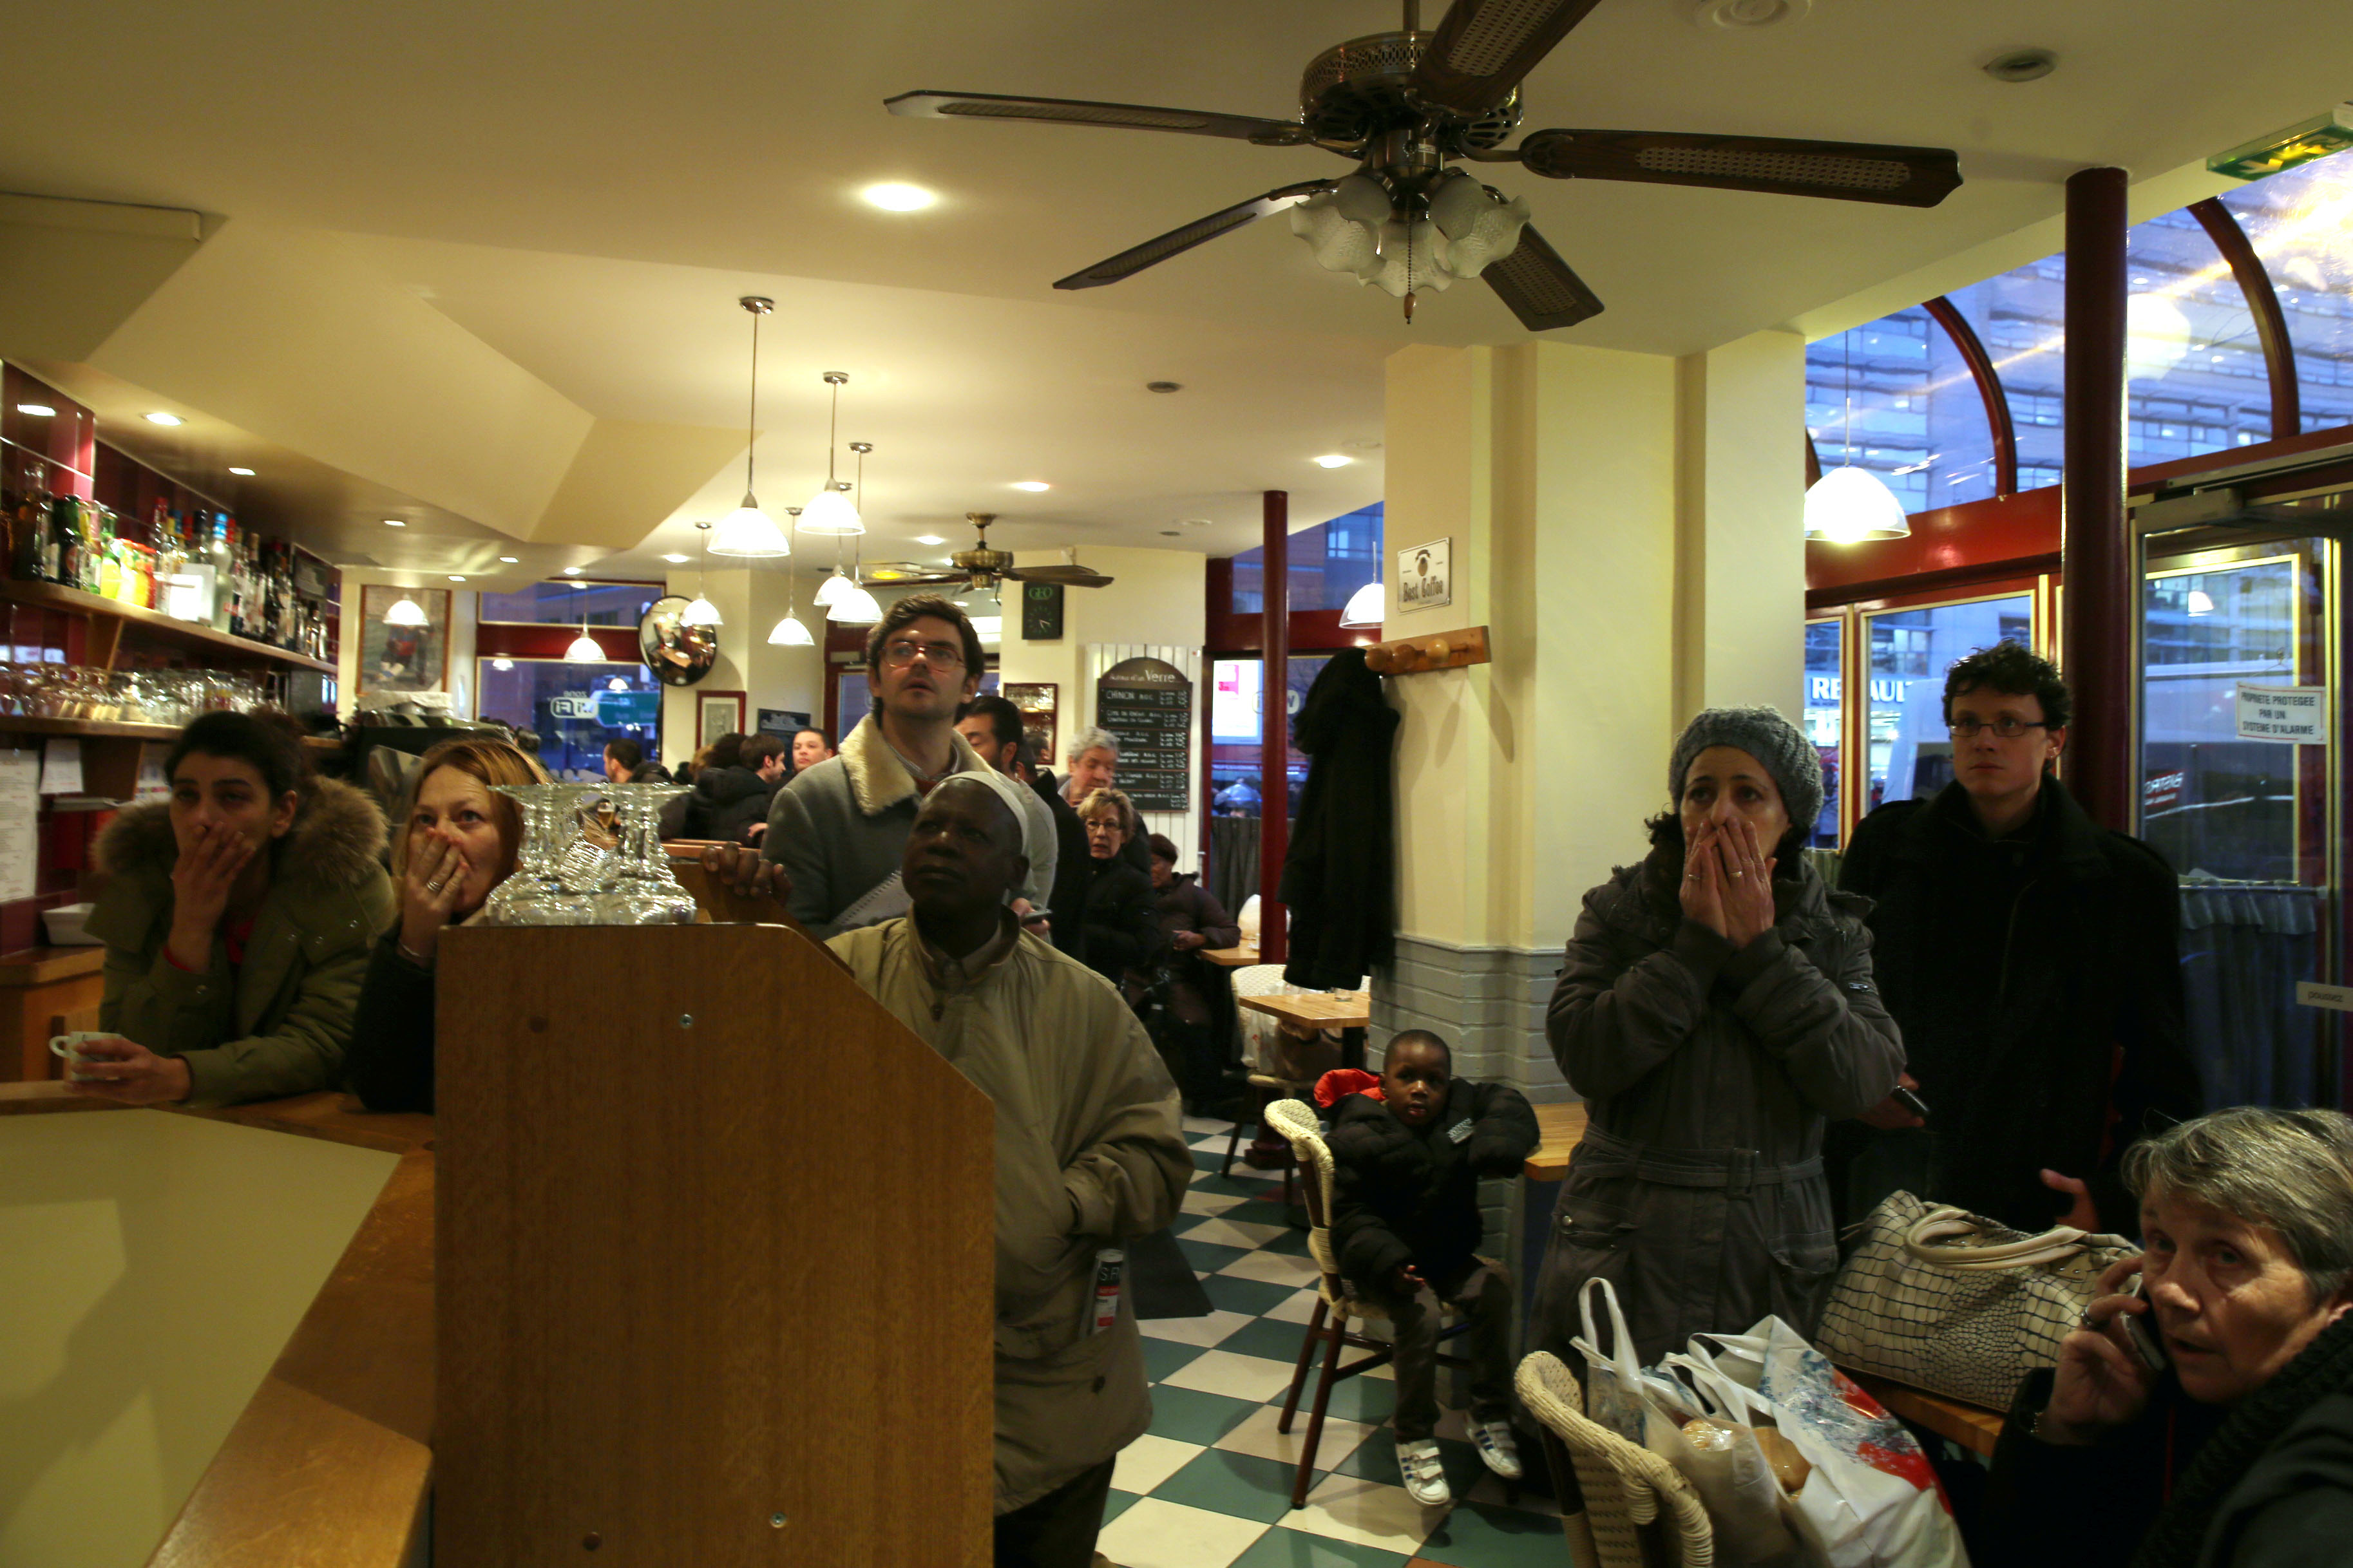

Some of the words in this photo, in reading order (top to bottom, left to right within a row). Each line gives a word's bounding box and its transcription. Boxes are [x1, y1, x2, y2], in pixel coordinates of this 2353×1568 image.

[1403, 582, 1418, 602] Best
[1422, 576, 1443, 598] Coffee
[1145, 669, 1176, 682] Verre
[2241, 692, 2271, 705] PROPRIETE
[2272, 695, 2315, 706] PROTEGEE
[2259, 709, 2272, 719] PAR
[2274, 710, 2286, 719] UN
[2242, 721, 2270, 733] SYSTEME
[2272, 724, 2314, 735] D'ALARME
